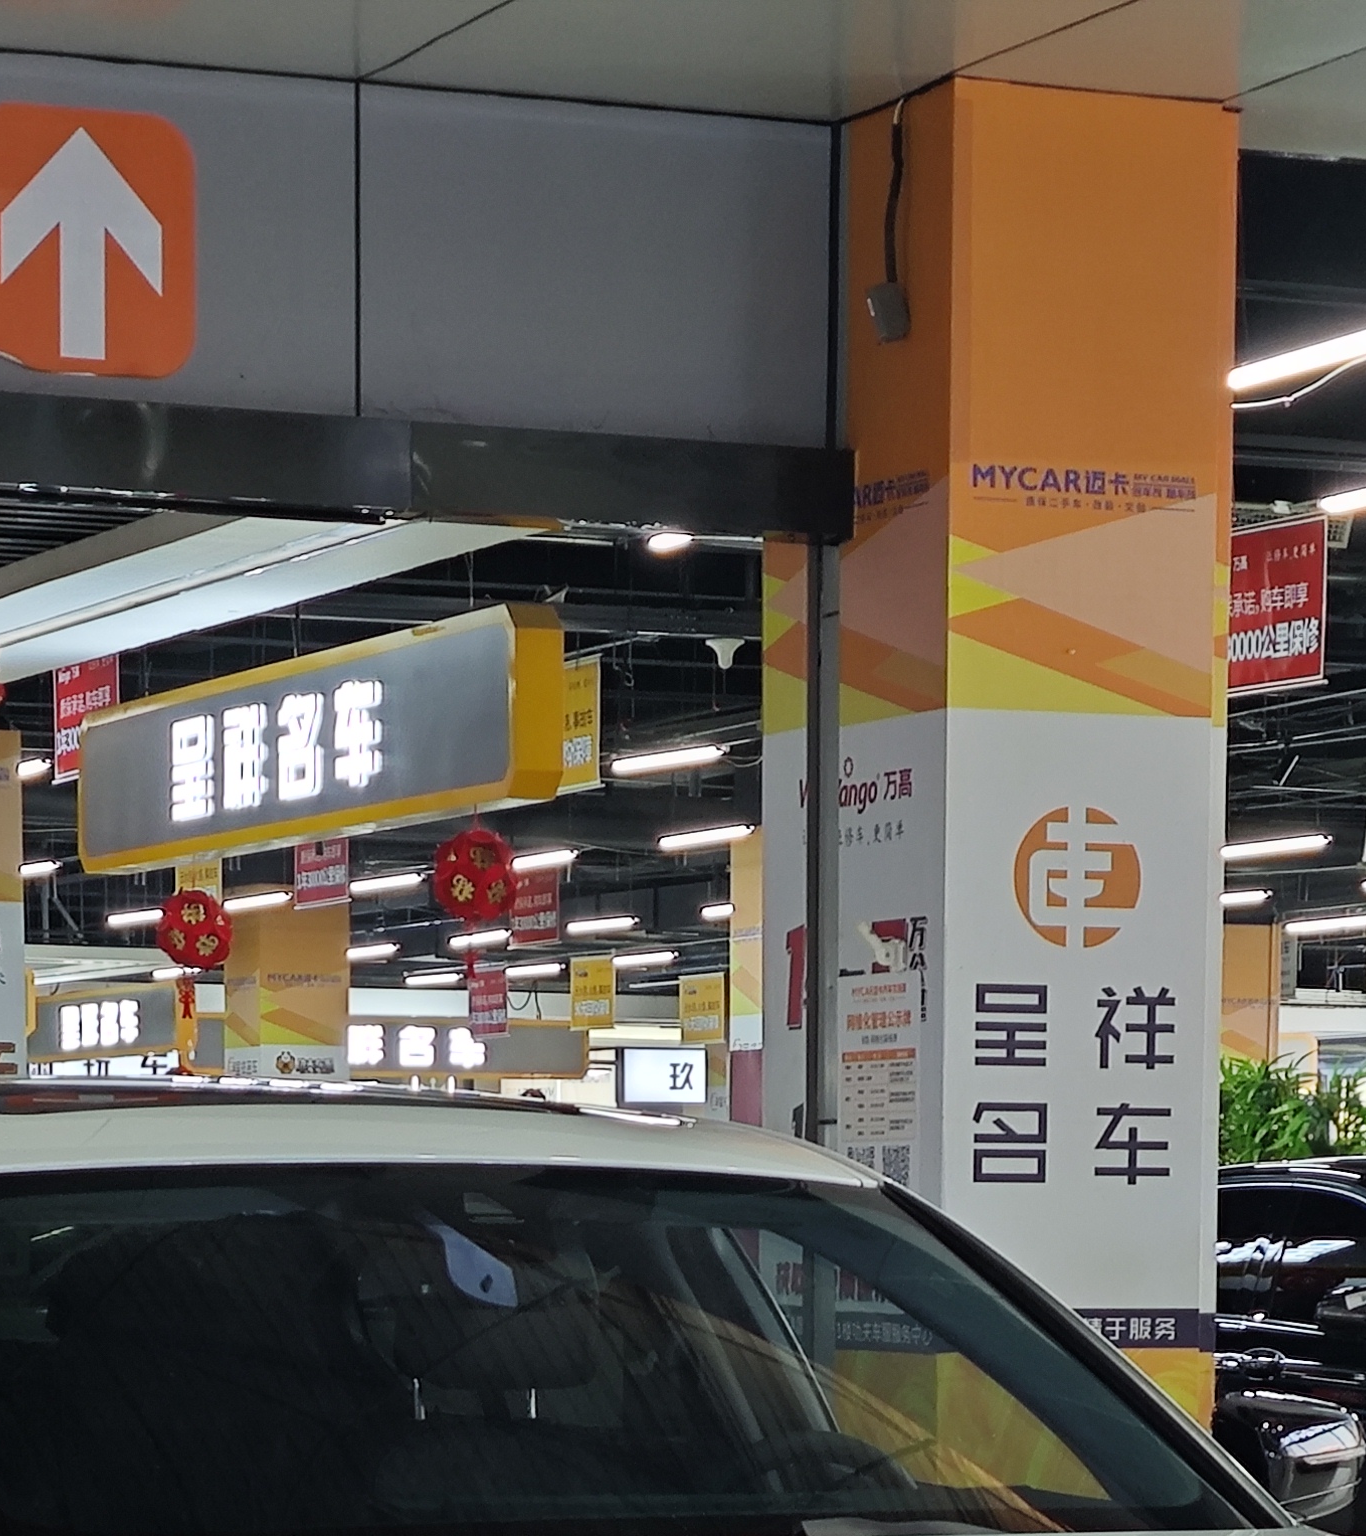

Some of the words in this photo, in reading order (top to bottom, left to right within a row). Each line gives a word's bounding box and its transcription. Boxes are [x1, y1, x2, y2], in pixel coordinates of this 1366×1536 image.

[169, 679, 384, 824] 呈祥名车
[838, 775, 878, 814] ango
[884, 768, 912, 801] 万高
[975, 983, 1176, 1070] 呈祥
[669, 1062, 695, 1091] 玖
[973, 1103, 1172, 1185] 名车
